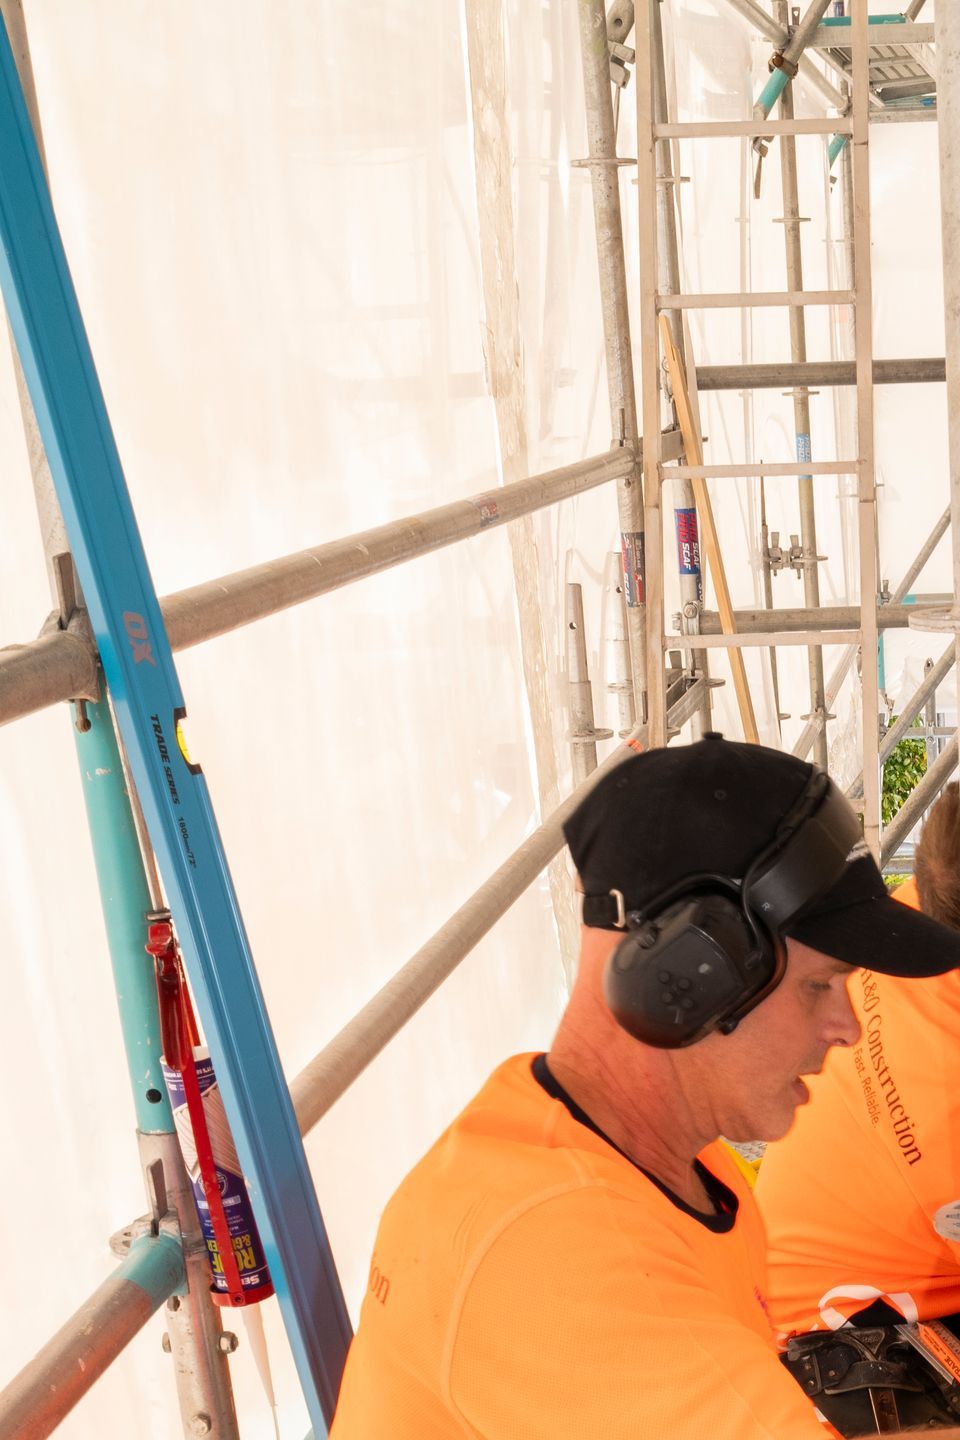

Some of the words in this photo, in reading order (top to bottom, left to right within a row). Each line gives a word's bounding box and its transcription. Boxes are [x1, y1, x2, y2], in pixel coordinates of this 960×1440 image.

[682, 542, 691, 570] SCAF
[123, 611, 157, 667] OX
[150, 714, 171, 763] TRADE
[161, 764, 181, 805] SERIES
[861, 1076, 880, 1128] Reliable.
[866, 1014, 922, 1167] Construction
